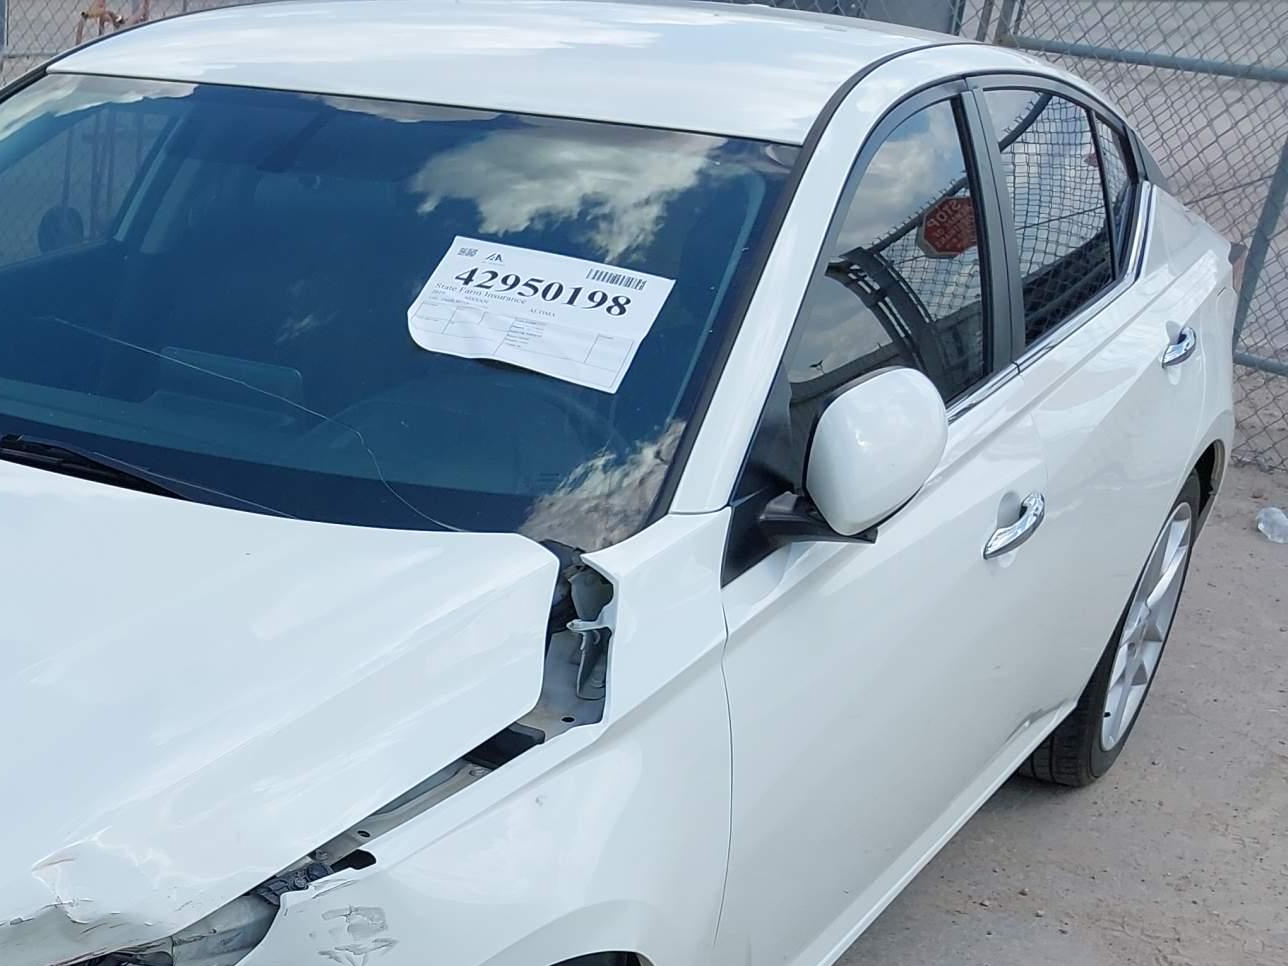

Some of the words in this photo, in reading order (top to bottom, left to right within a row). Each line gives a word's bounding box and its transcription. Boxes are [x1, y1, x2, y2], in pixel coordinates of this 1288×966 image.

[435, 282, 458, 291] State
[459, 286, 482, 297] Farm
[484, 291, 527, 305] Insurance
[454, 267, 632, 317] 42950198
